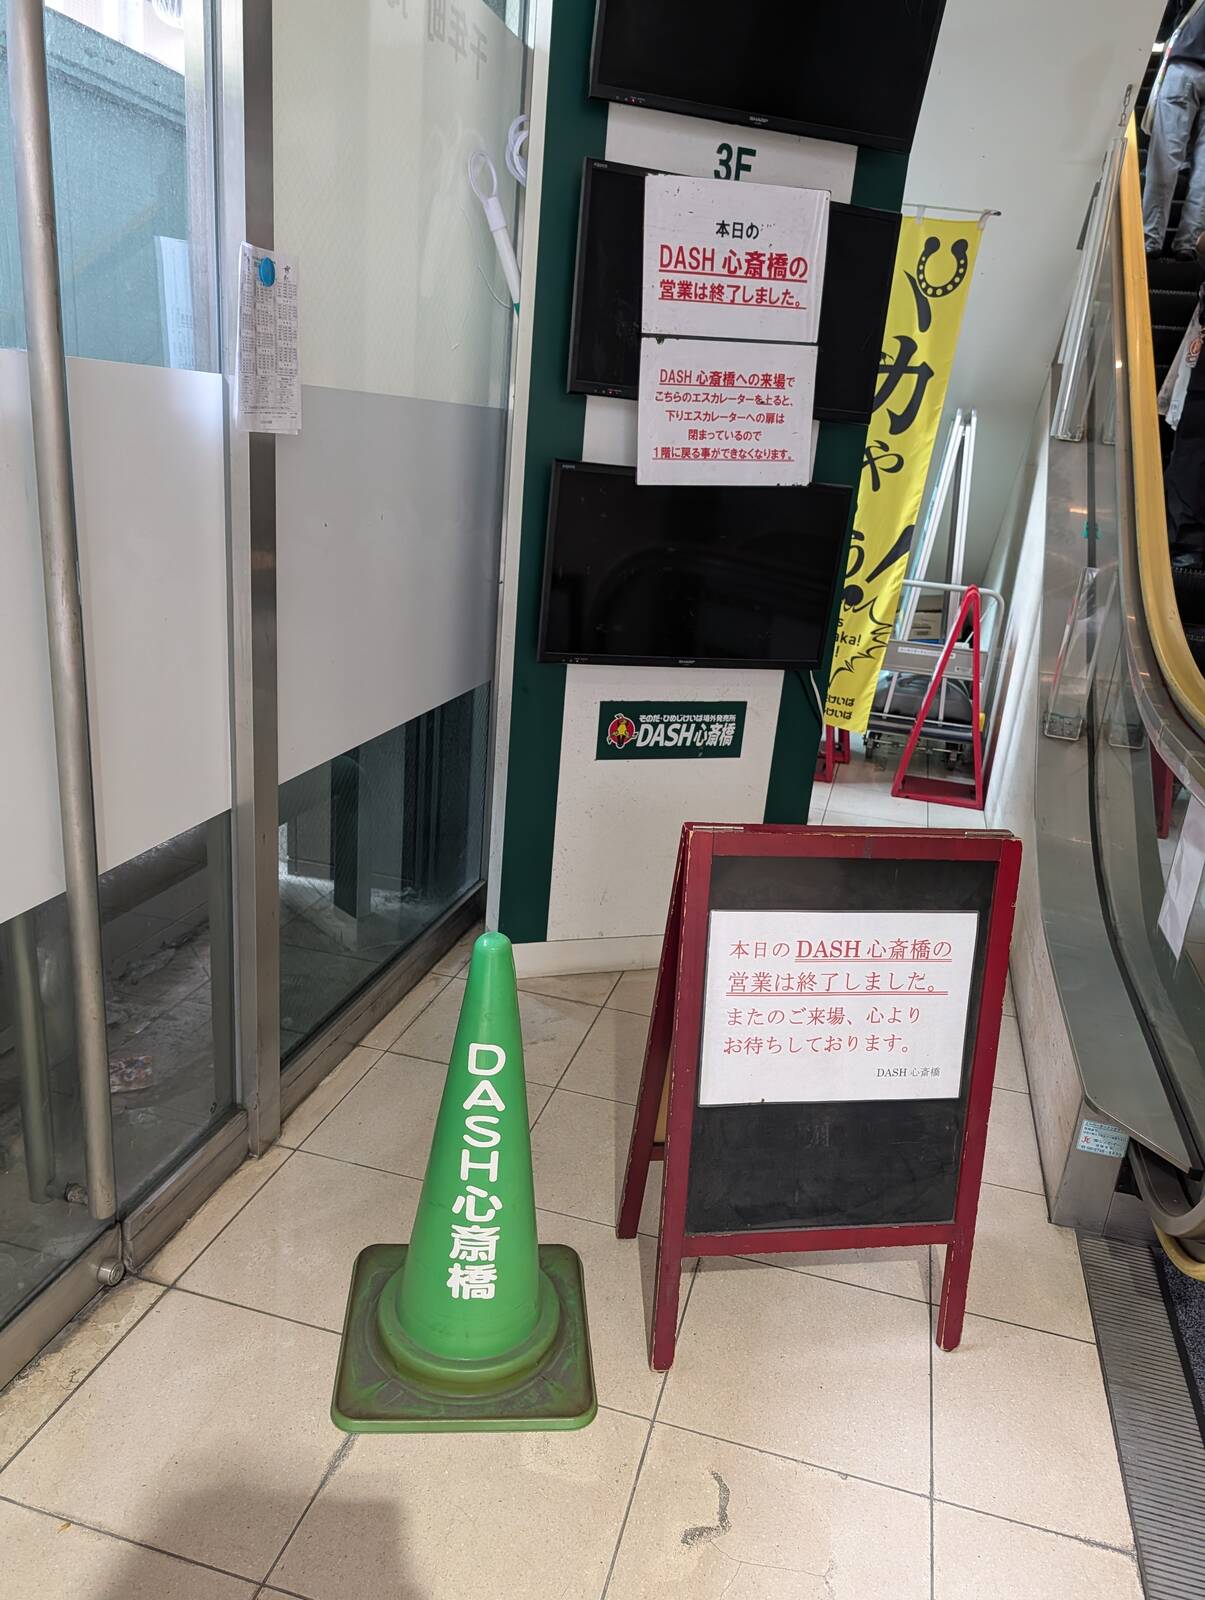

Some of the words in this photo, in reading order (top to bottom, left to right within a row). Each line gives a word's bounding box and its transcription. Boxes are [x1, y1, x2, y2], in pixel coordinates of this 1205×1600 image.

[714, 142, 757, 181] 3F
[715, 220, 760, 240] 本日の
[659, 244, 715, 272] DASH
[722, 249, 808, 279] 心斎橋の
[659, 279, 801, 308] 営業は終了しました。
[659, 369, 692, 384] DASH
[696, 370, 796, 389] 心斎橋への来場で
[665, 409, 785, 425] 下りエスカレーターへの扉は
[687, 428, 762, 442] 閉まっているので
[635, 722, 737, 747] DASH心斎橋
[728, 939, 791, 960] 本日の
[795, 940, 861, 959] DASH
[867, 938, 952, 960] 心斎橋の
[728, 971, 936, 993] 営業は終了しました。
[727, 1006, 921, 1026] またのご来場、心より
[723, 1033, 909, 1055] お待ちしております。
[876, 1067, 907, 1078] DASH
[910, 1066, 941, 1078] 心斎橋
